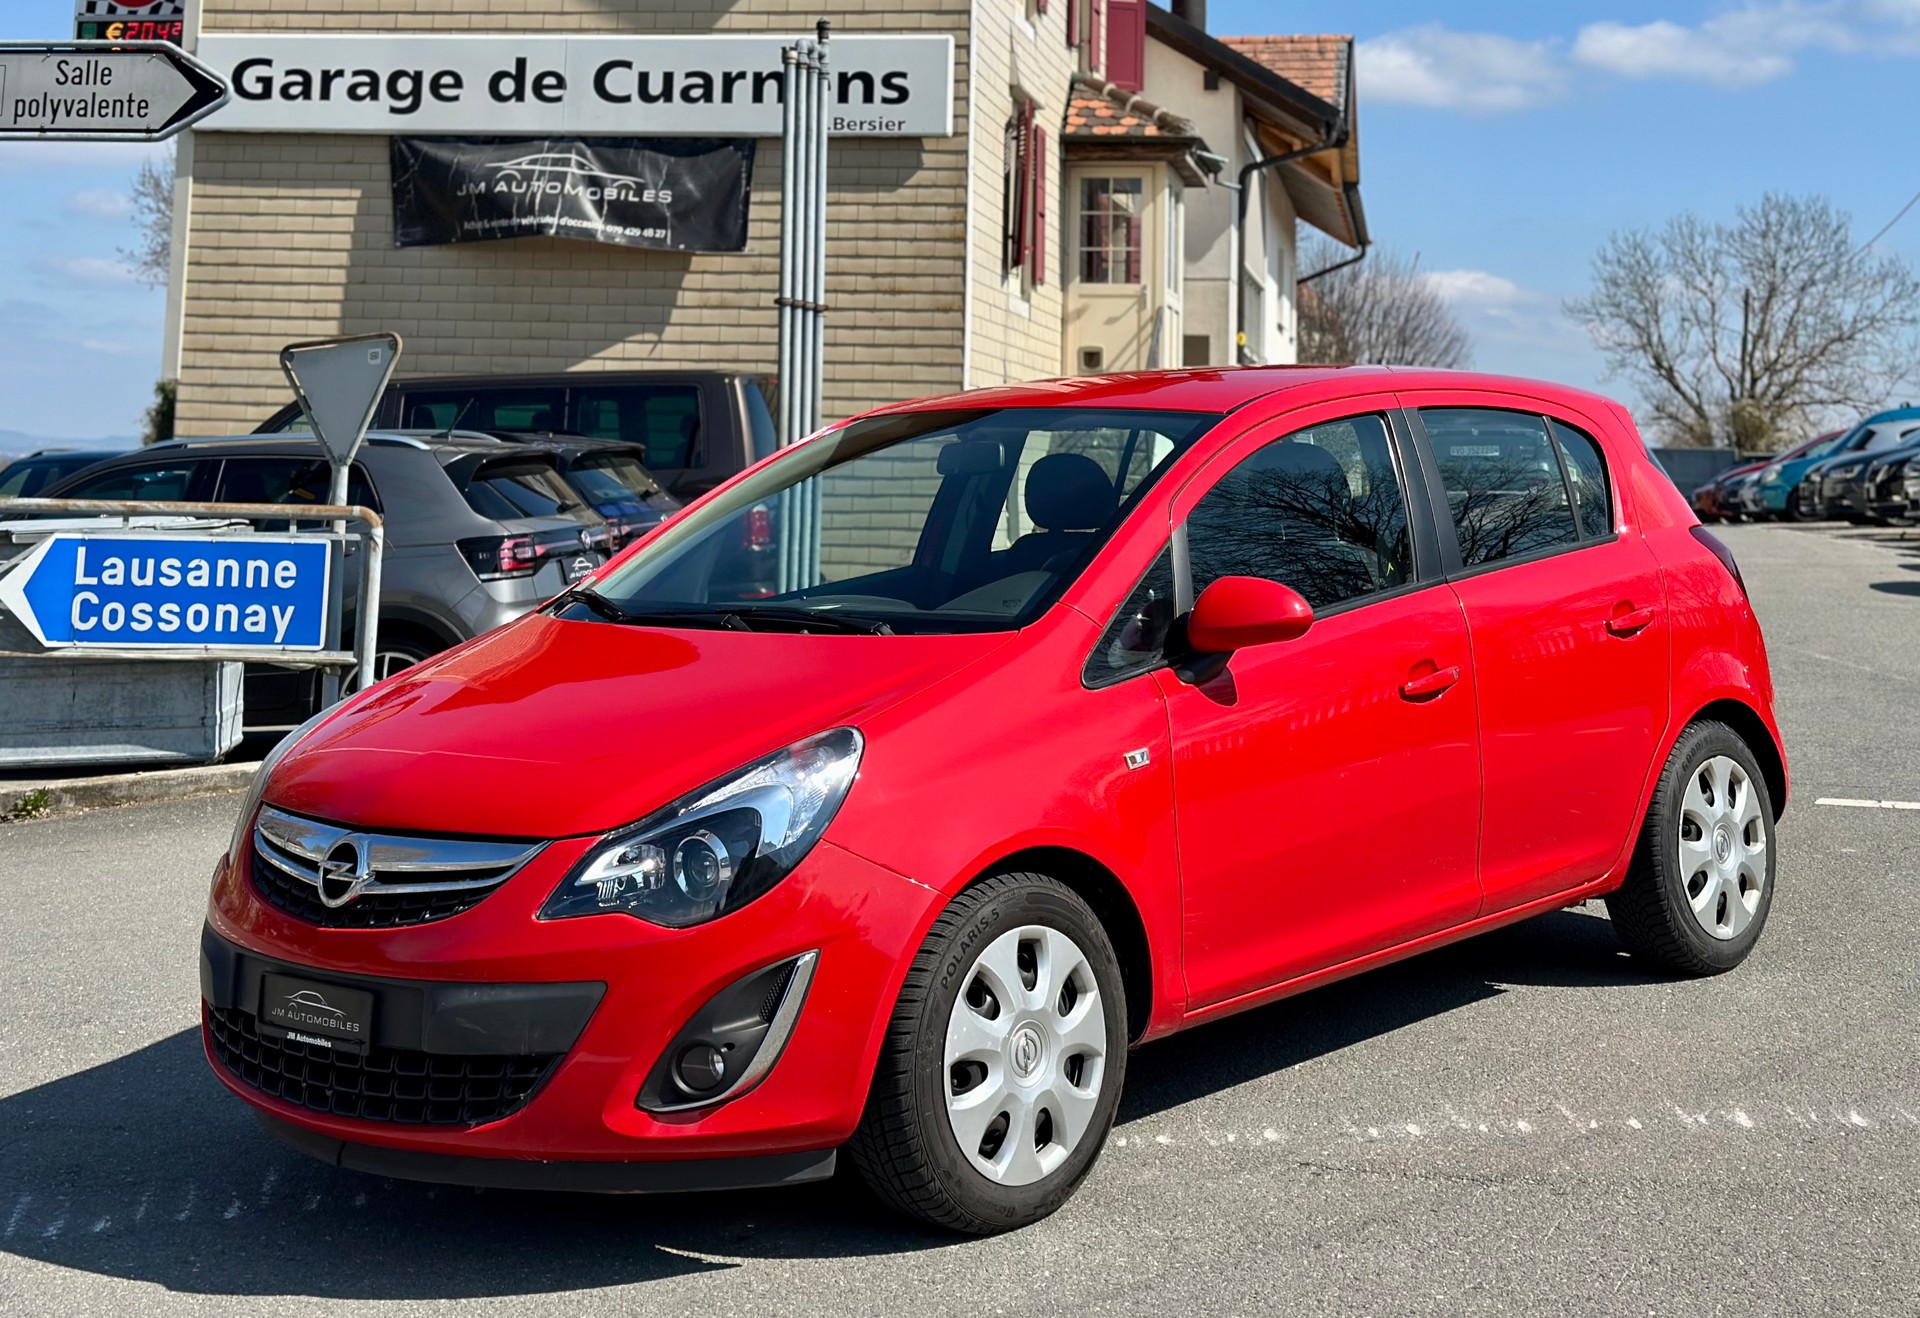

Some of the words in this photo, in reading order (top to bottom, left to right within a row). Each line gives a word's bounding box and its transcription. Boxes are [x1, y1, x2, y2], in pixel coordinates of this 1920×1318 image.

[55, 60, 113, 86] Salle
[231, 58, 465, 114] Garage
[487, 57, 567, 103] de
[593, 59, 910, 105] Cuarnns
[13, 92, 149, 125] polyvalente
[827, 116, 906, 132] .Bersier
[457, 181, 487, 196] JM
[494, 180, 673, 204] AUTOMOBILES
[624, 228, 641, 236] 429
[655, 229, 666, 238] 27
[75, 546, 298, 588] Lausanne
[71, 591, 297, 644] Cossonay
[941, 917, 989, 990] POLARIS
[991, 907, 1000, 921] 5
[271, 1008, 285, 1017] JM
[287, 1011, 360, 1033] AUTOMOBILES
[287, 1032, 296, 1040] JM
[296, 1033, 332, 1048] Automobiles
